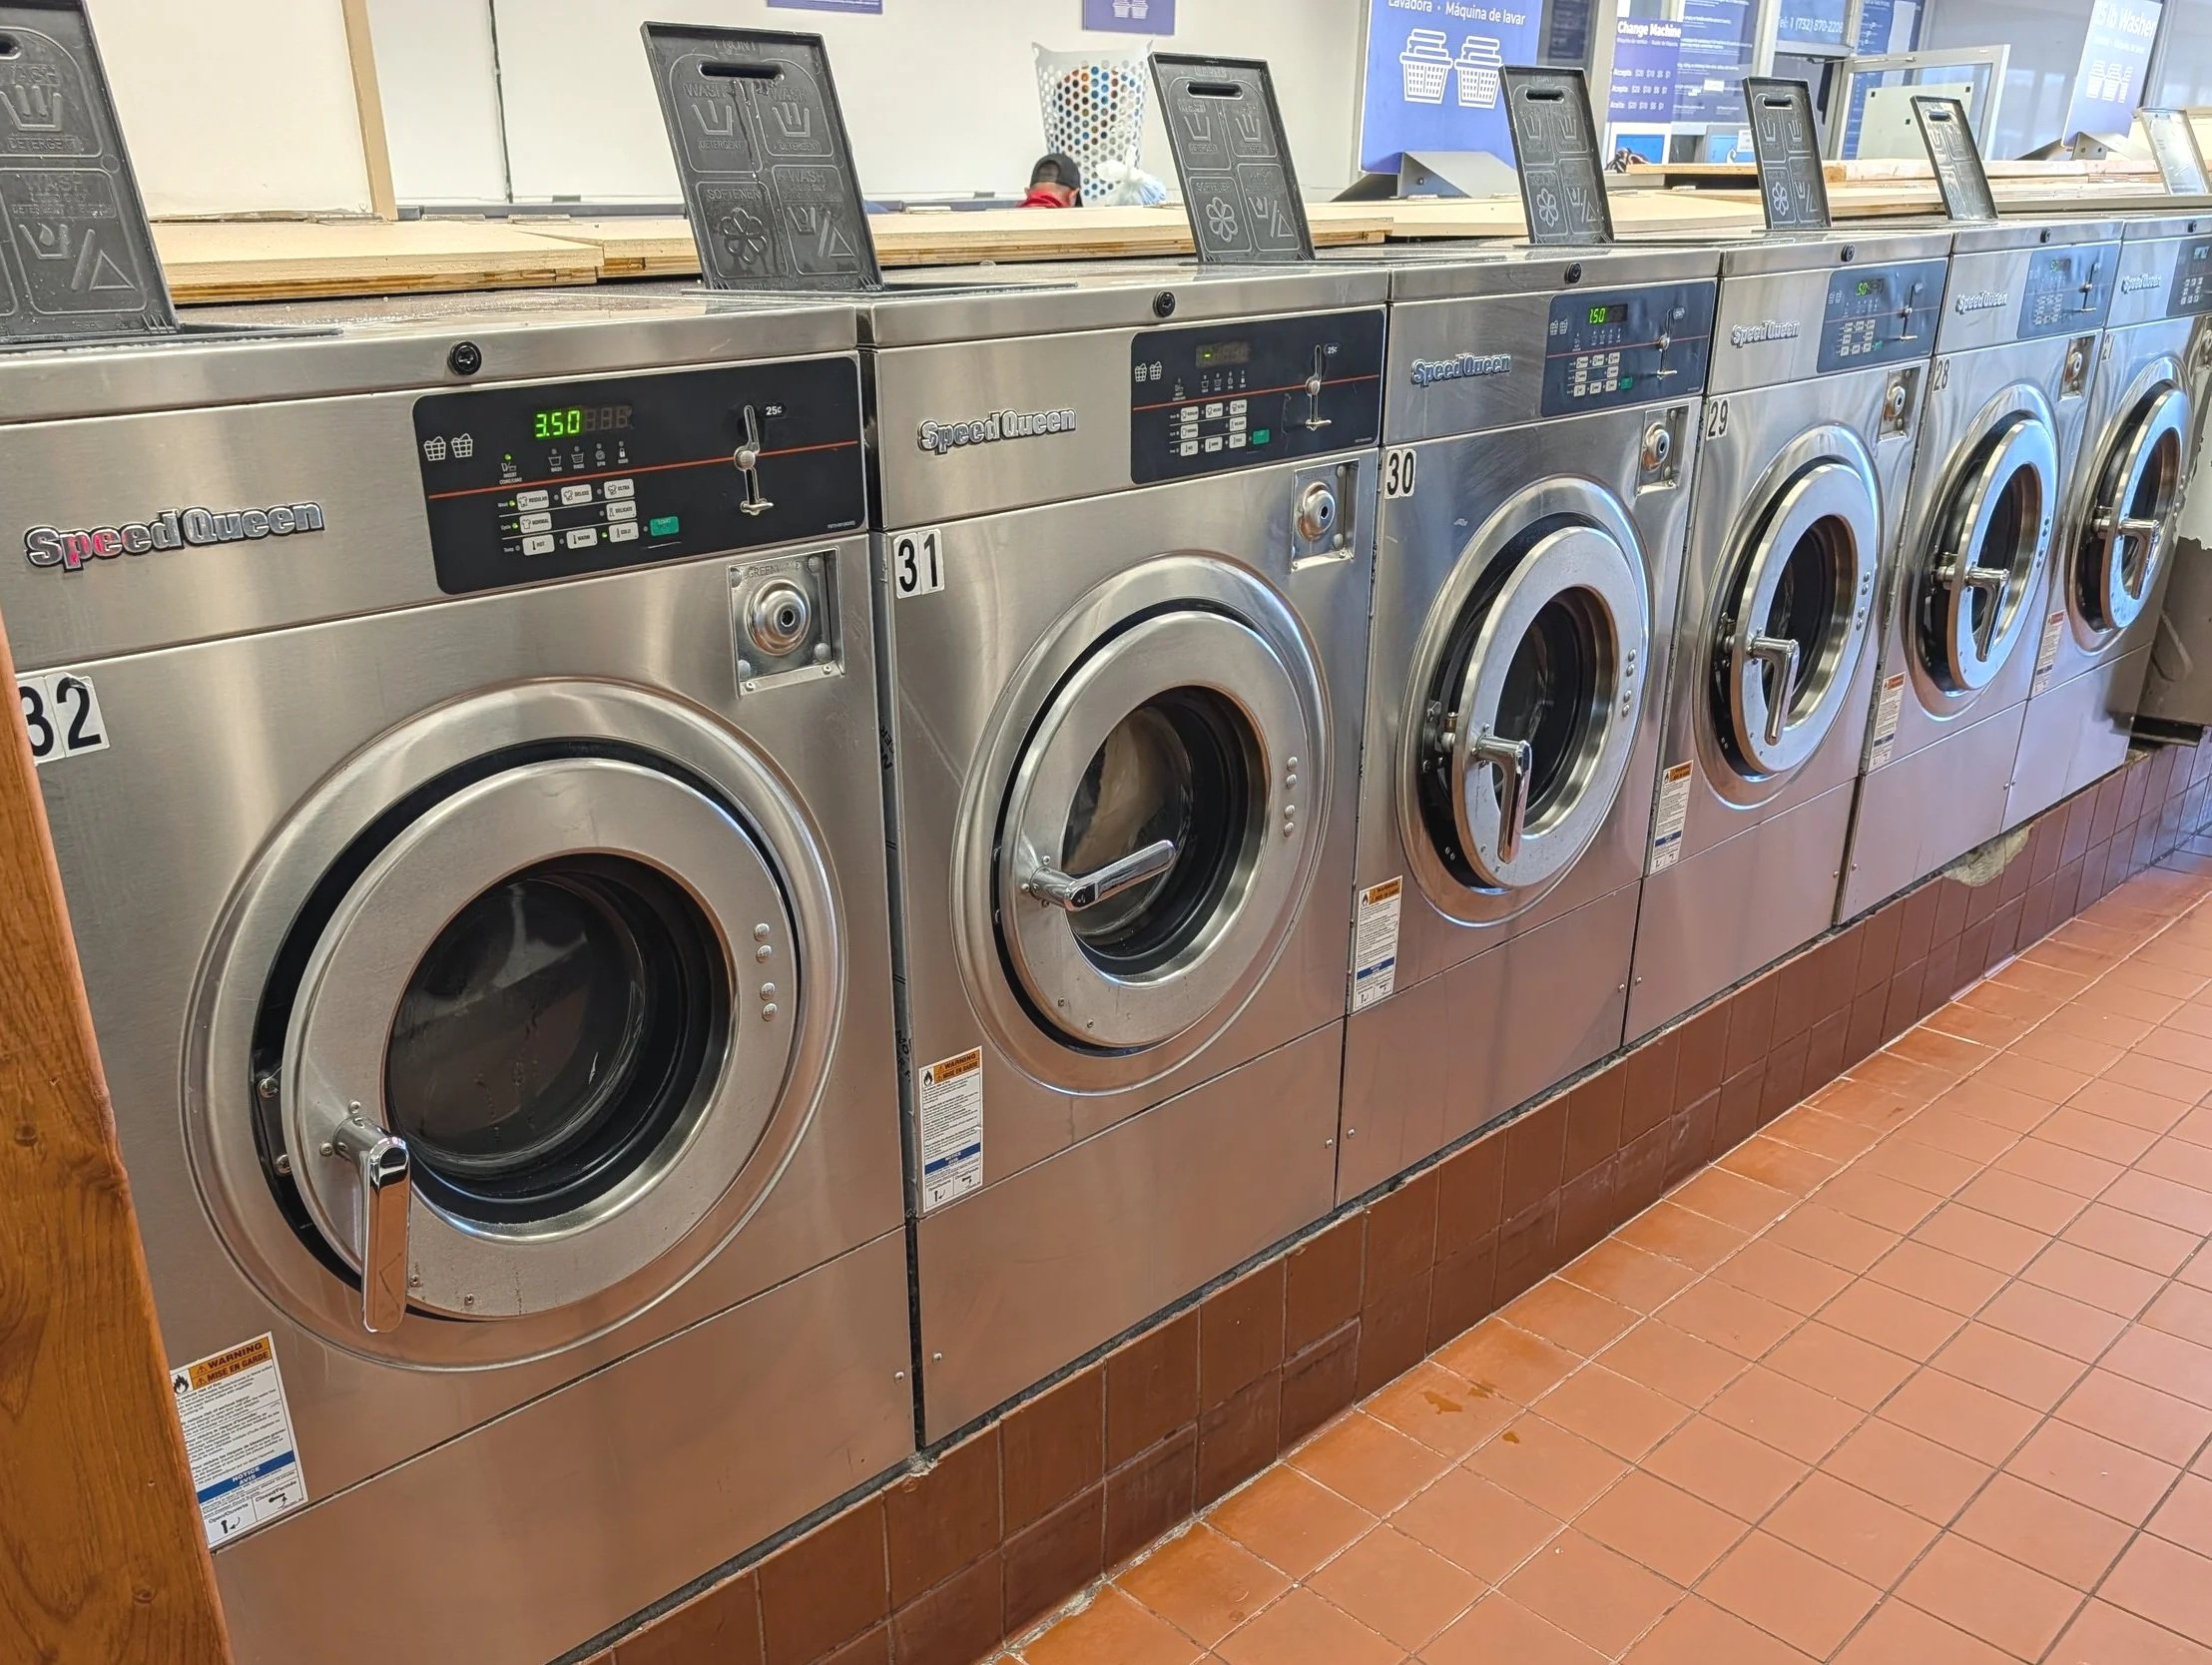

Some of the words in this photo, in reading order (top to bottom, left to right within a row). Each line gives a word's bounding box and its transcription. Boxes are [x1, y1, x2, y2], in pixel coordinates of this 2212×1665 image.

[1388, 0, 1432, 12] Lavadora
[1445, 3, 1486, 20] Máquina
[1488, 8, 1501, 22] de
[1502, 10, 1525, 26] lavar
[1617, 20, 1649, 38] Change
[1650, 23, 1682, 38] Machine
[1933, 359, 1949, 391] 28
[535, 409, 581, 437] 3.50
[765, 405, 783, 416] 25¢
[1708, 400, 1729, 438] 29
[1386, 450, 1414, 496] 30
[897, 533, 939, 593] 31
[19, 676, 102, 757] 32
[207, 1341, 263, 1370] WARNING
[207, 1367, 229, 1382] MISE
[229, 1362, 241, 1373] EN
[241, 1351, 269, 1368] GARDE
[232, 1464, 261, 1483] NOTICE
[238, 1472, 257, 1485] AVIS
